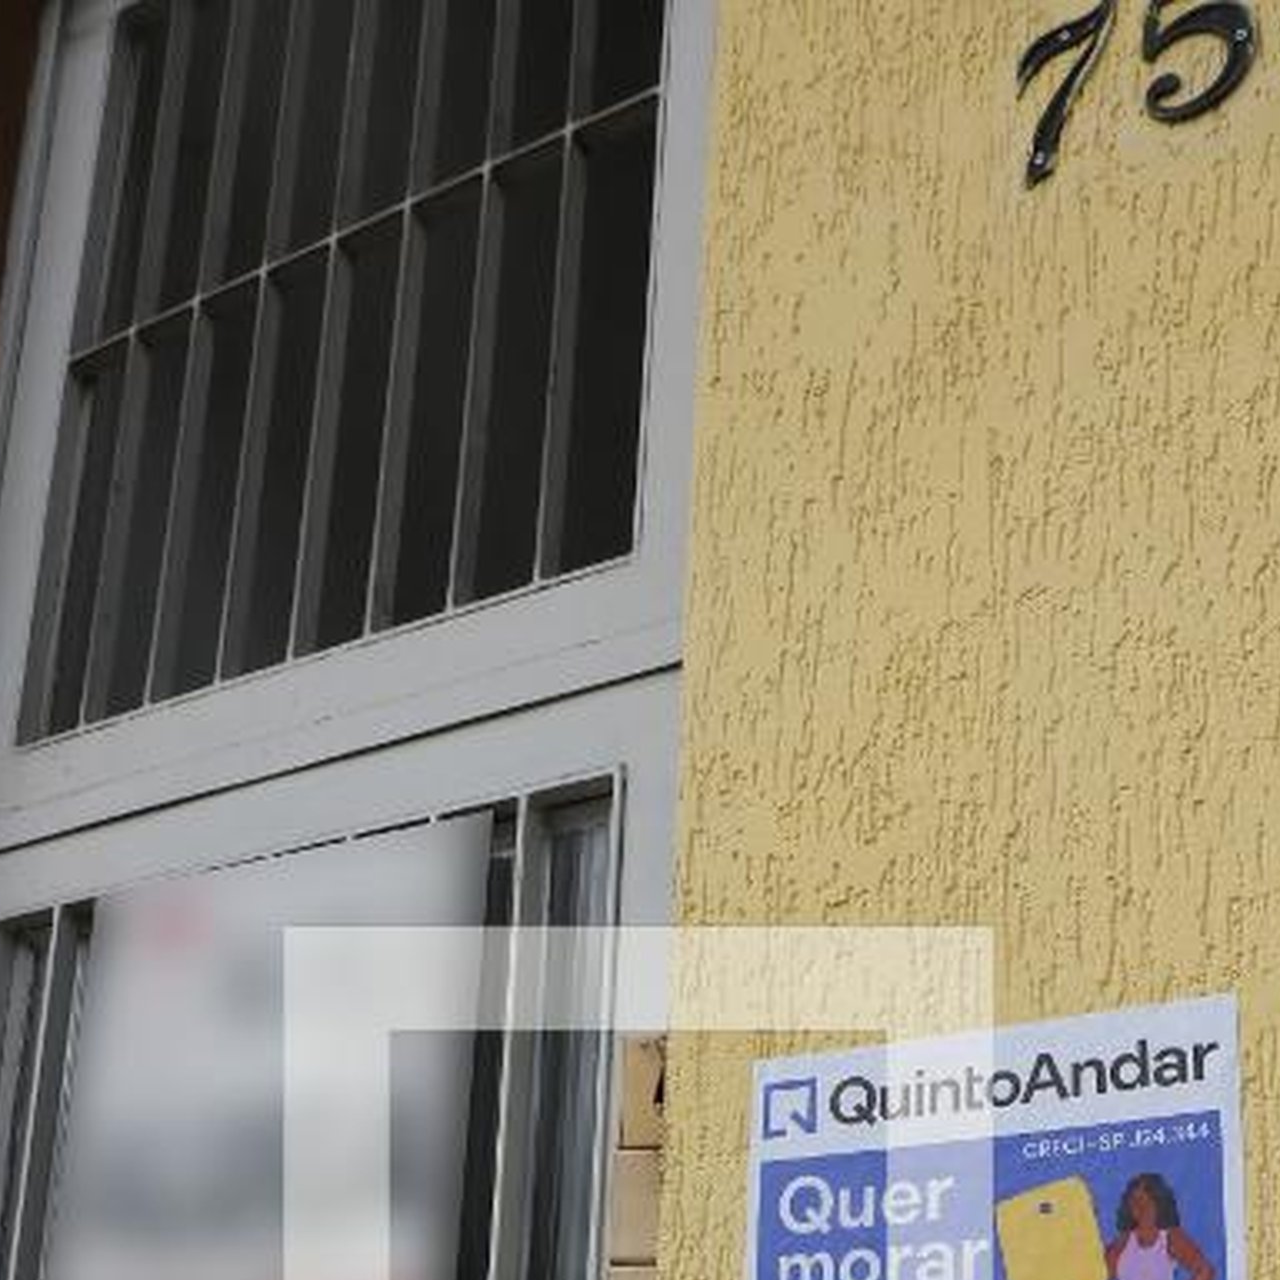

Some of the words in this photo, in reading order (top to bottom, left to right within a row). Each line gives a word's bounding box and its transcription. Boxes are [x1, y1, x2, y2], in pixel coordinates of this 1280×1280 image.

[1017, 0, 1256, 189] 75
[828, 1039, 1219, 1127] QuintoAndar
[779, 1175, 955, 1234] Quer
